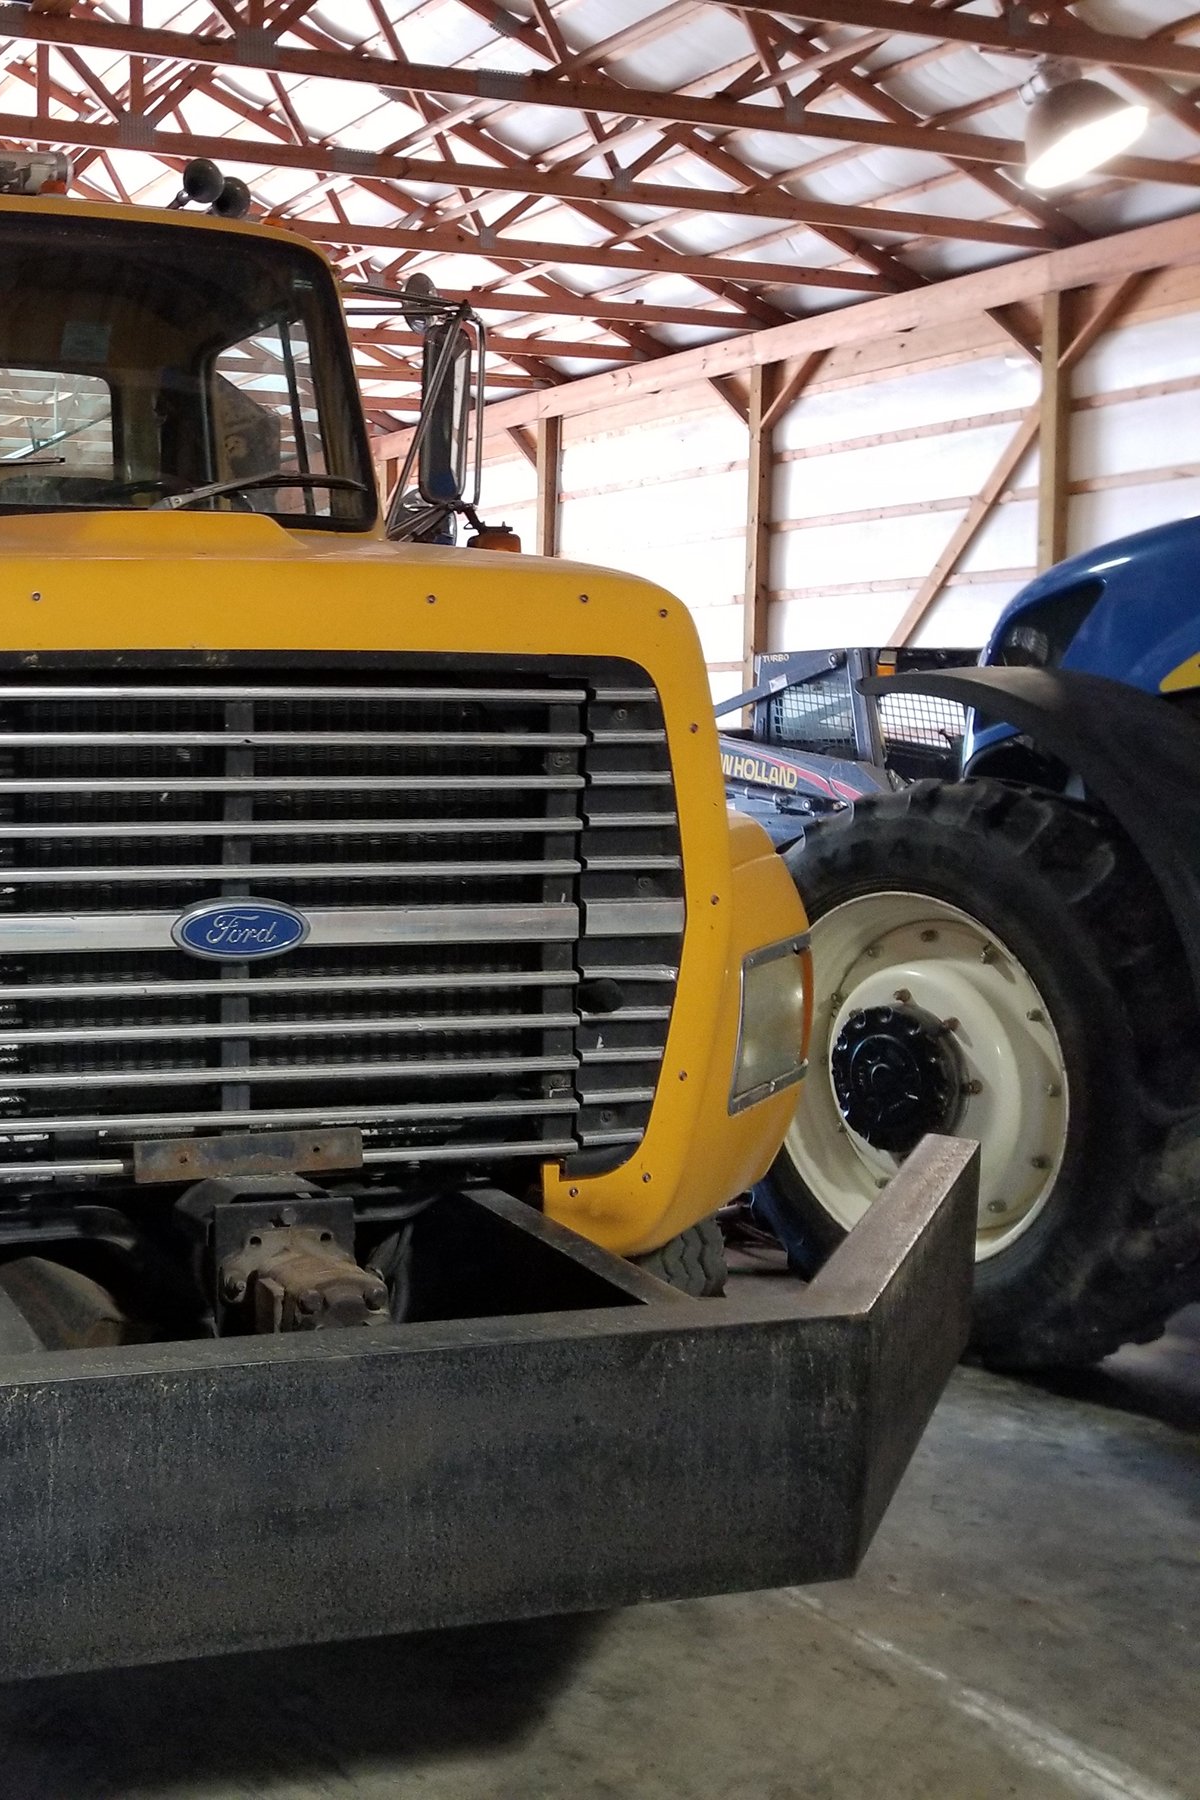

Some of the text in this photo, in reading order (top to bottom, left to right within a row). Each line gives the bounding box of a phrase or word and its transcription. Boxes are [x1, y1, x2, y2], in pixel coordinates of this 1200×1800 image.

[762, 653, 790, 664] TURBO
[734, 756, 798, 789] HOLLAND
[206, 914, 277, 944] Ford
